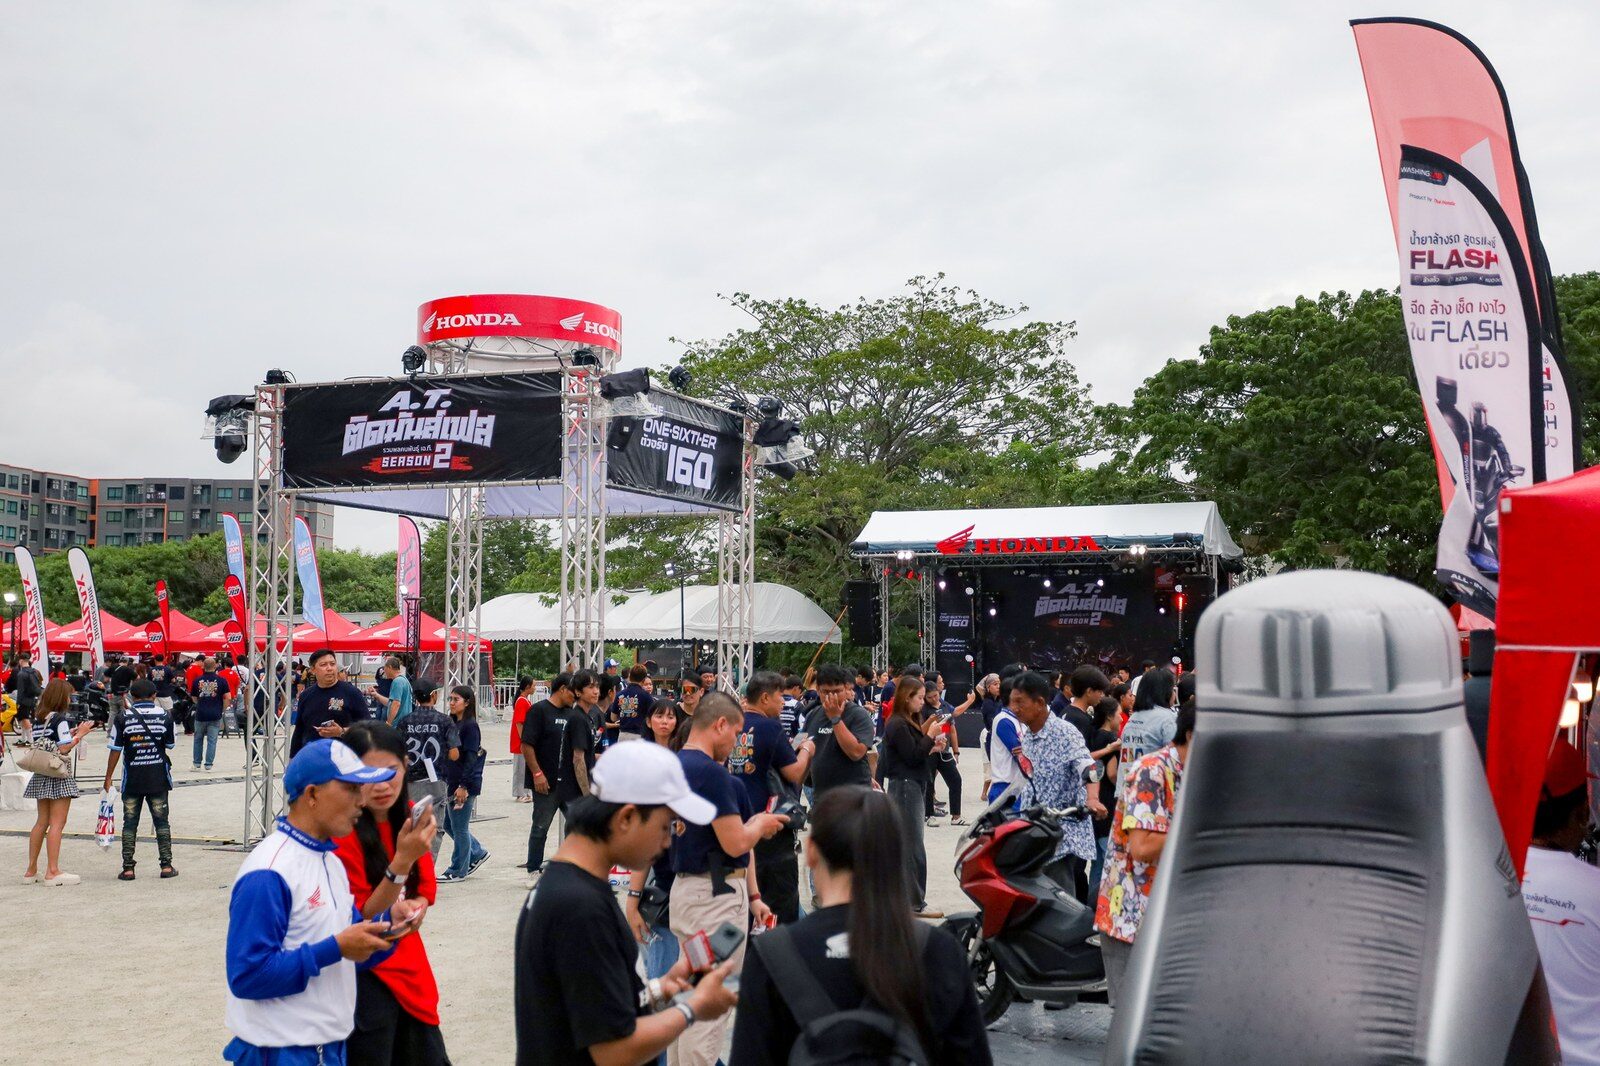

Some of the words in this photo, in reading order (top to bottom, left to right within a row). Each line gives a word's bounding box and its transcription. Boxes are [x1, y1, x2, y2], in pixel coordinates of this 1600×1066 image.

[1401, 166, 1431, 177] WASHING
[1410, 230, 1460, 246] น้ำยาล้างรถ
[1410, 249, 1499, 270] FLASH
[1411, 299, 1425, 315] ฉีด
[1430, 299, 1452, 315] ล้าง
[1456, 297, 1473, 315] เช็ด
[1479, 299, 1506, 315] เงาไว
[437, 313, 522, 330] HONDA
[1430, 320, 1508, 342] FLASH
[378, 388, 452, 412] A.T.
[640, 434, 668, 451] ตัวจริง
[381, 456, 432, 468] SEASON
[433, 443, 453, 469] 2
[666, 444, 714, 490] 160
[974, 536, 1102, 554] HONDA
[1451, 573, 1469, 583] ALL
[948, 619, 969, 627] 160
[1089, 611, 1102, 626] 2
[406, 724, 440, 734] READ
[405, 736, 441, 767] 30
